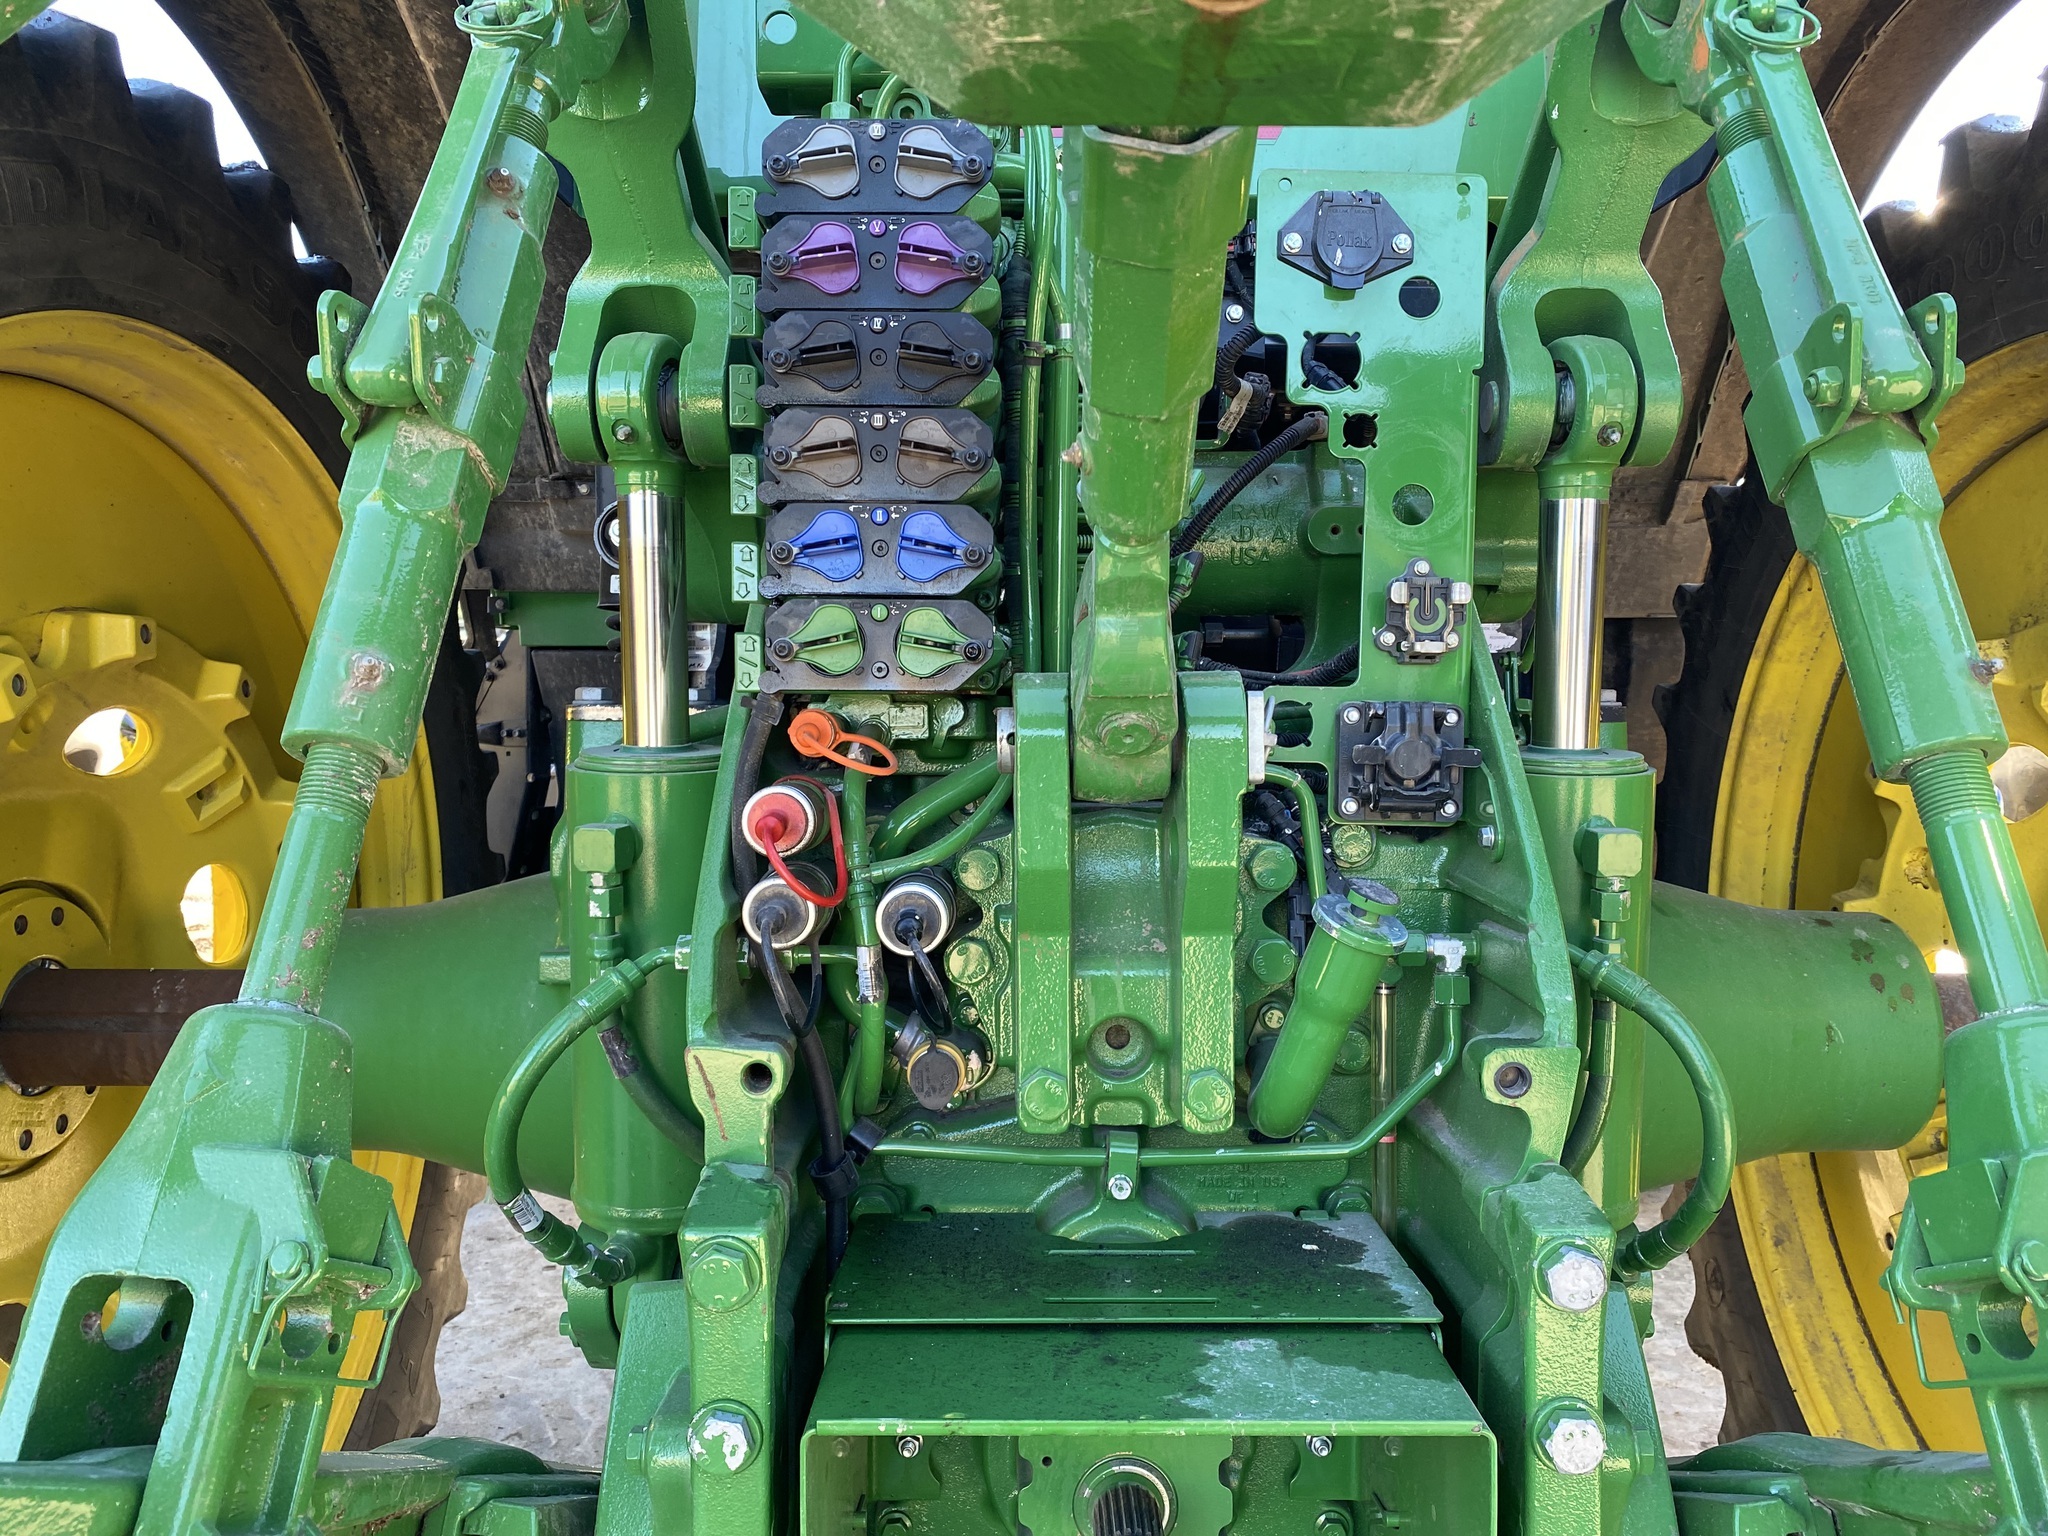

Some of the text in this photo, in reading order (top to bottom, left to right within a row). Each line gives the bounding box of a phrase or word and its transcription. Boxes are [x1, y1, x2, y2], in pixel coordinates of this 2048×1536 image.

[872, 221, 883, 232] V
[1327, 230, 1372, 248] Pollak
[873, 317, 883, 329] IV
[873, 414, 883, 426] III
[876, 510, 883, 521] II
[1231, 502, 1281, 520] RAW
[1230, 546, 1271, 567] USA
[1196, 1174, 1232, 1188] MADE
[1261, 1174, 1289, 1188] USA
